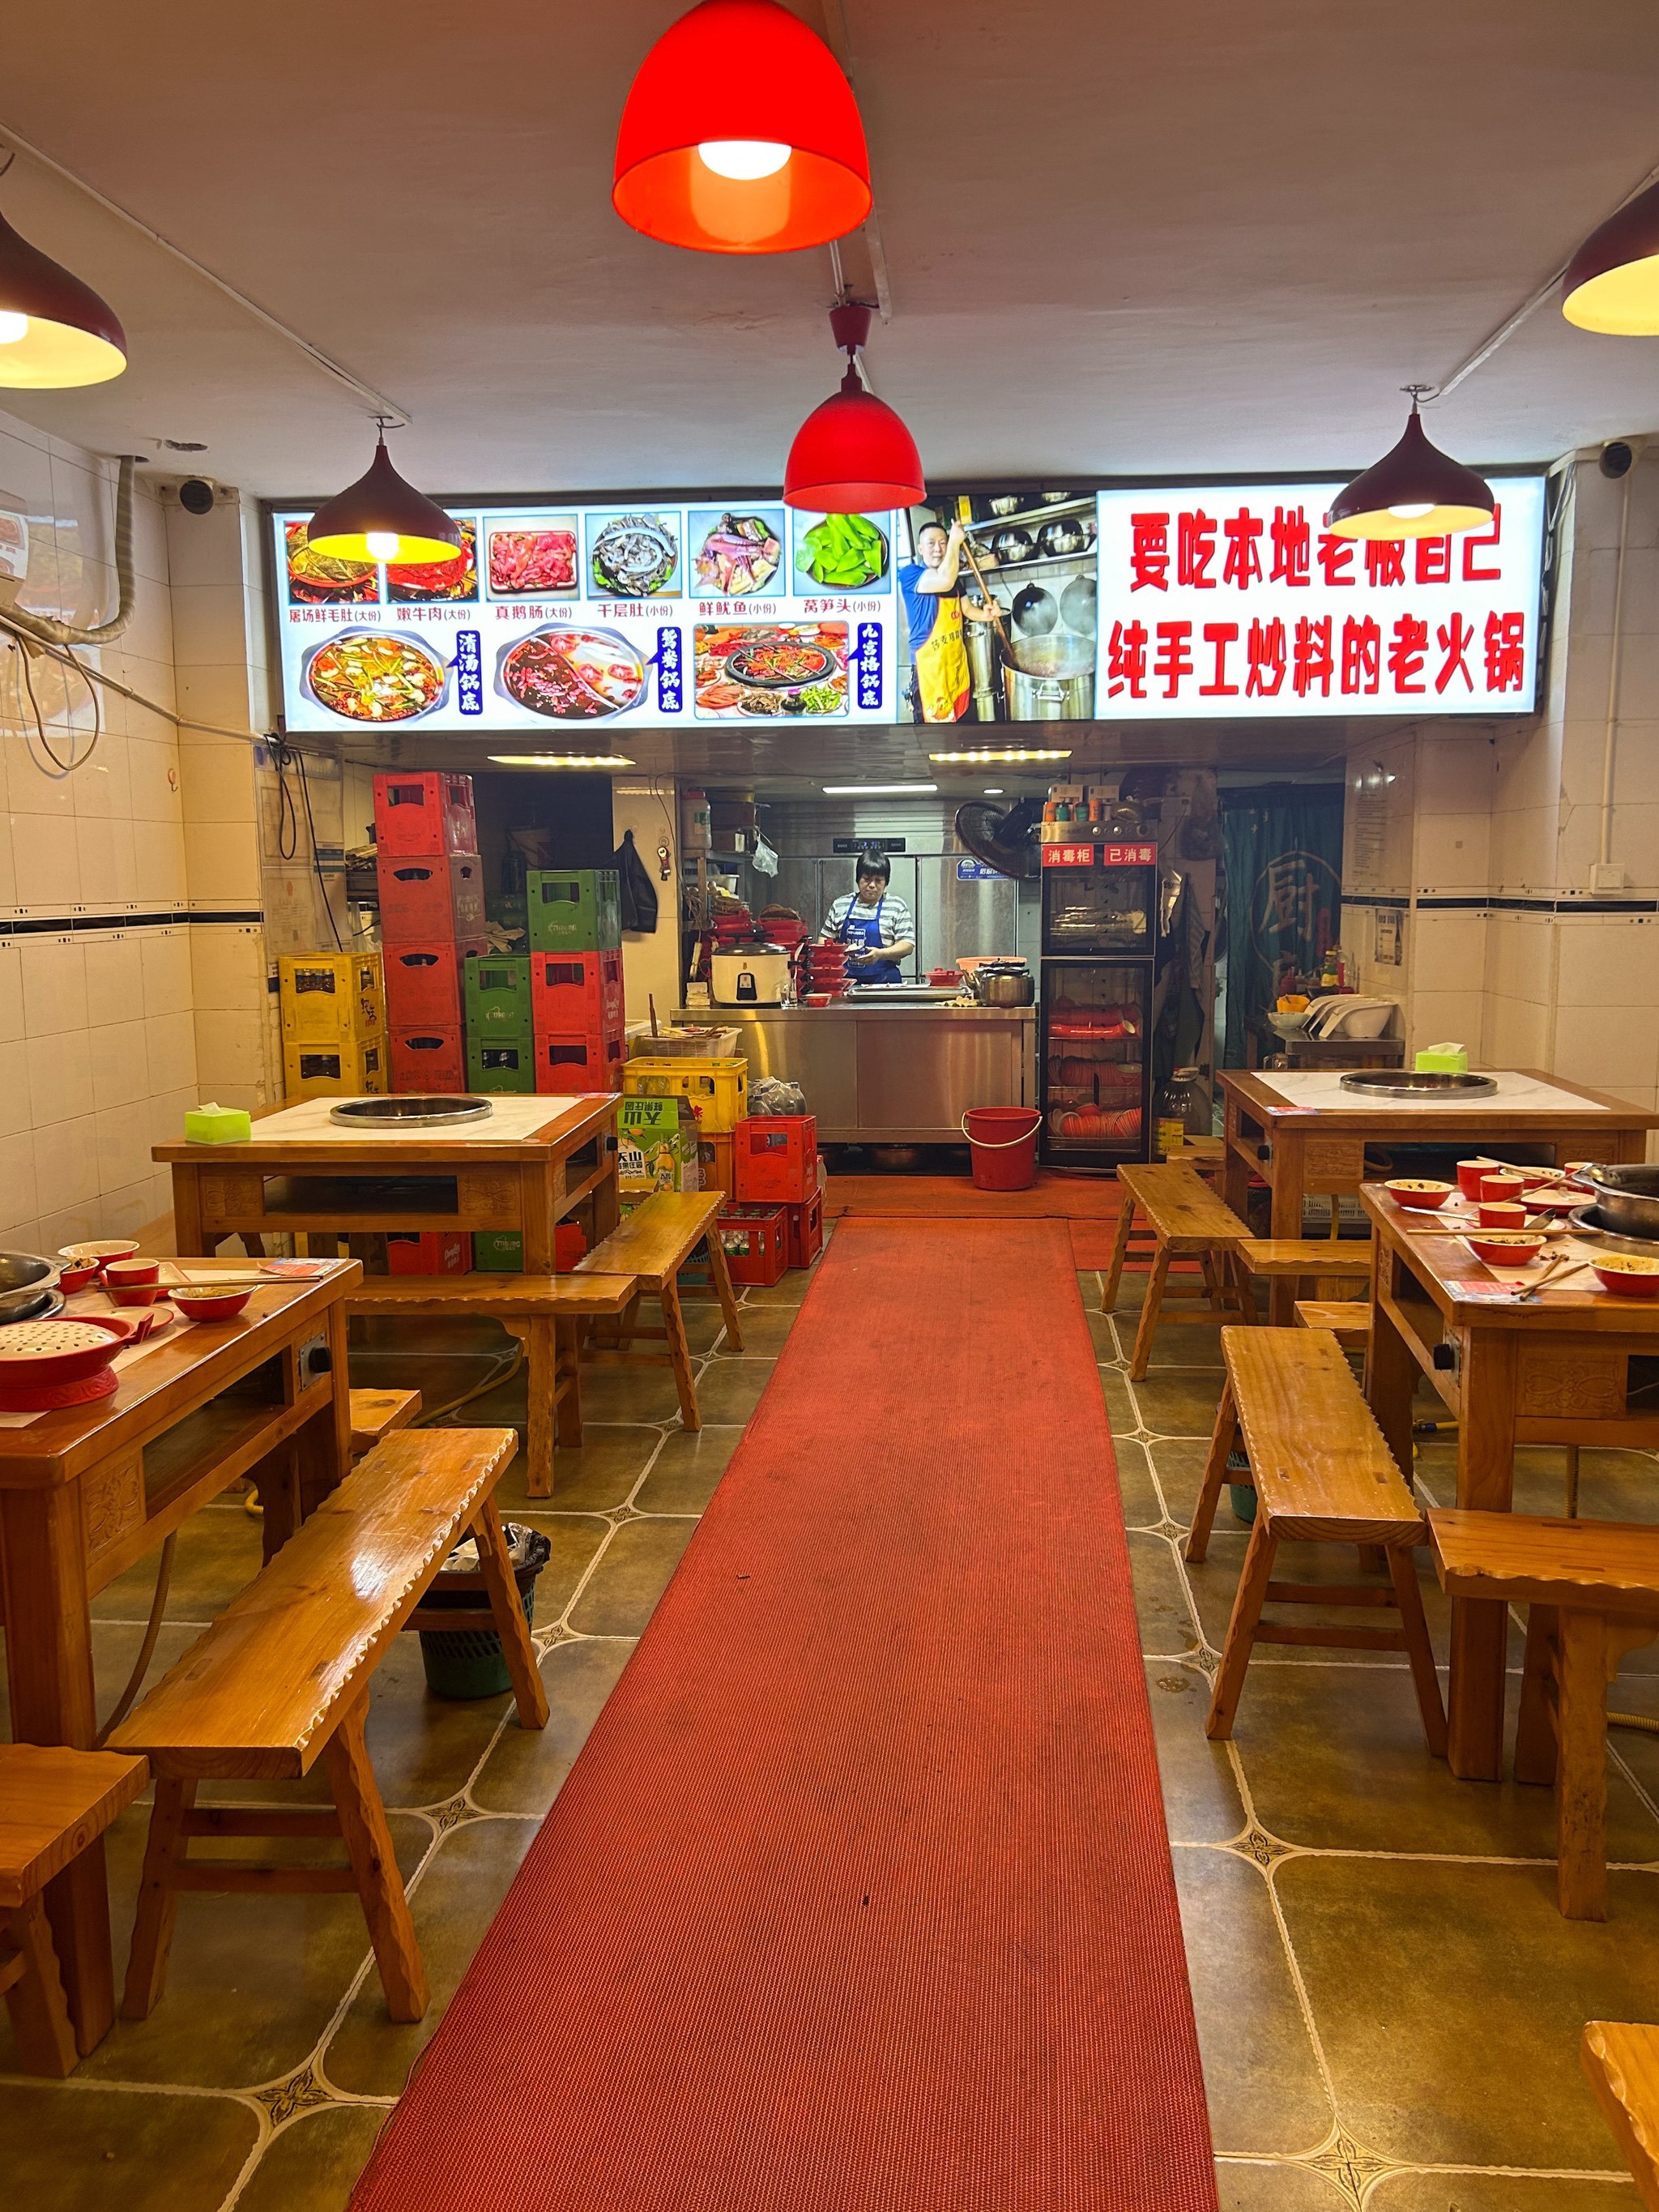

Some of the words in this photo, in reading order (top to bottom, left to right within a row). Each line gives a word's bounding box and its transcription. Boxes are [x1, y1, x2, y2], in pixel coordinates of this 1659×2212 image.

[495, 604, 573, 620] 真鹅肠(大份)
[597, 603, 673, 618] 千层肚(小份)
[698, 601, 777, 616] 鲜鱿鱼(小份)
[803, 598, 881, 614] 莴笋头(小份)
[396, 607, 471, 621] 嫩牛肉(大份)
[1107, 611, 1525, 698] 纯手工炒料的老火锅
[659, 628, 680, 711] 鸳鸯锅底
[859, 623, 881, 706] 九宫格锅底
[458, 634, 480, 711] 清汤锅底
[1048, 849, 1090, 864] 消毒柜
[1110, 848, 1152, 862] 已消毒
[624, 1112, 661, 1125] 天山
